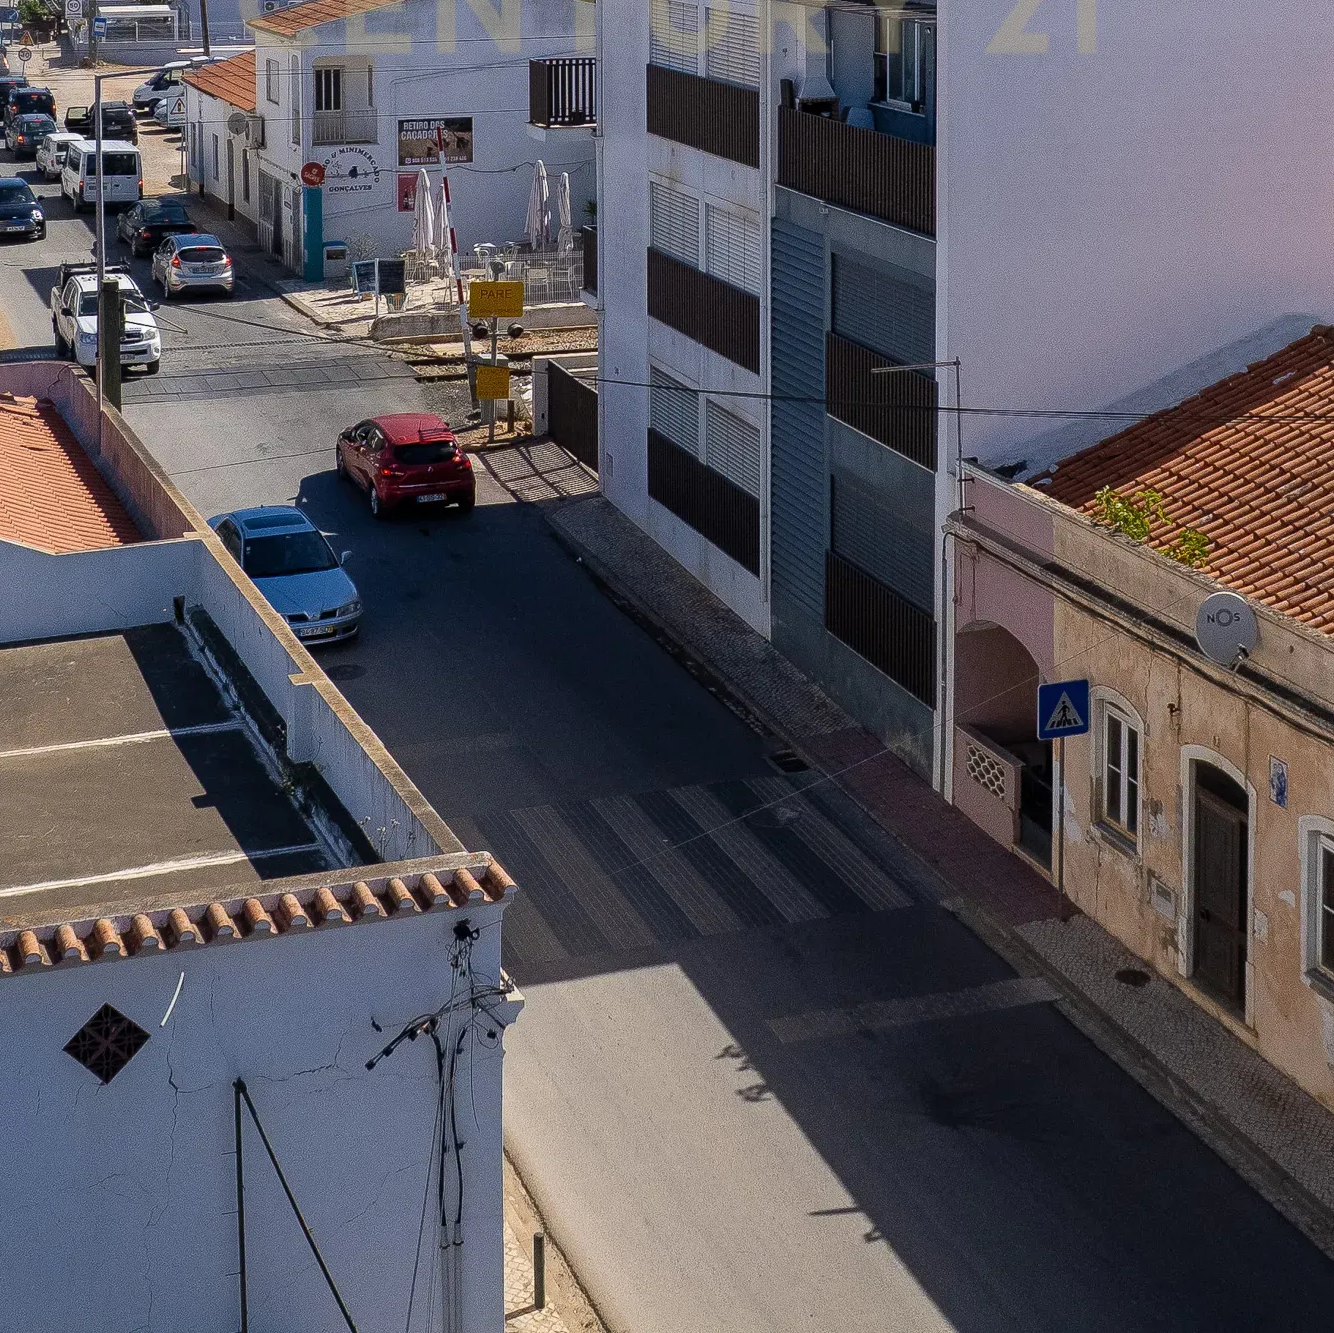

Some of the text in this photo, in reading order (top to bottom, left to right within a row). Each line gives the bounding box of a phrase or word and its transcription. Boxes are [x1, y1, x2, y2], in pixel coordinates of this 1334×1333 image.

[403, 121, 429, 130] RETIRO
[401, 129, 449, 141] CAÇADORS
[339, 146, 380, 184] MINIMERCADO
[328, 184, 373, 193] GONÇALVES
[480, 288, 513, 299] PARE
[1207, 608, 1241, 627] NOS
